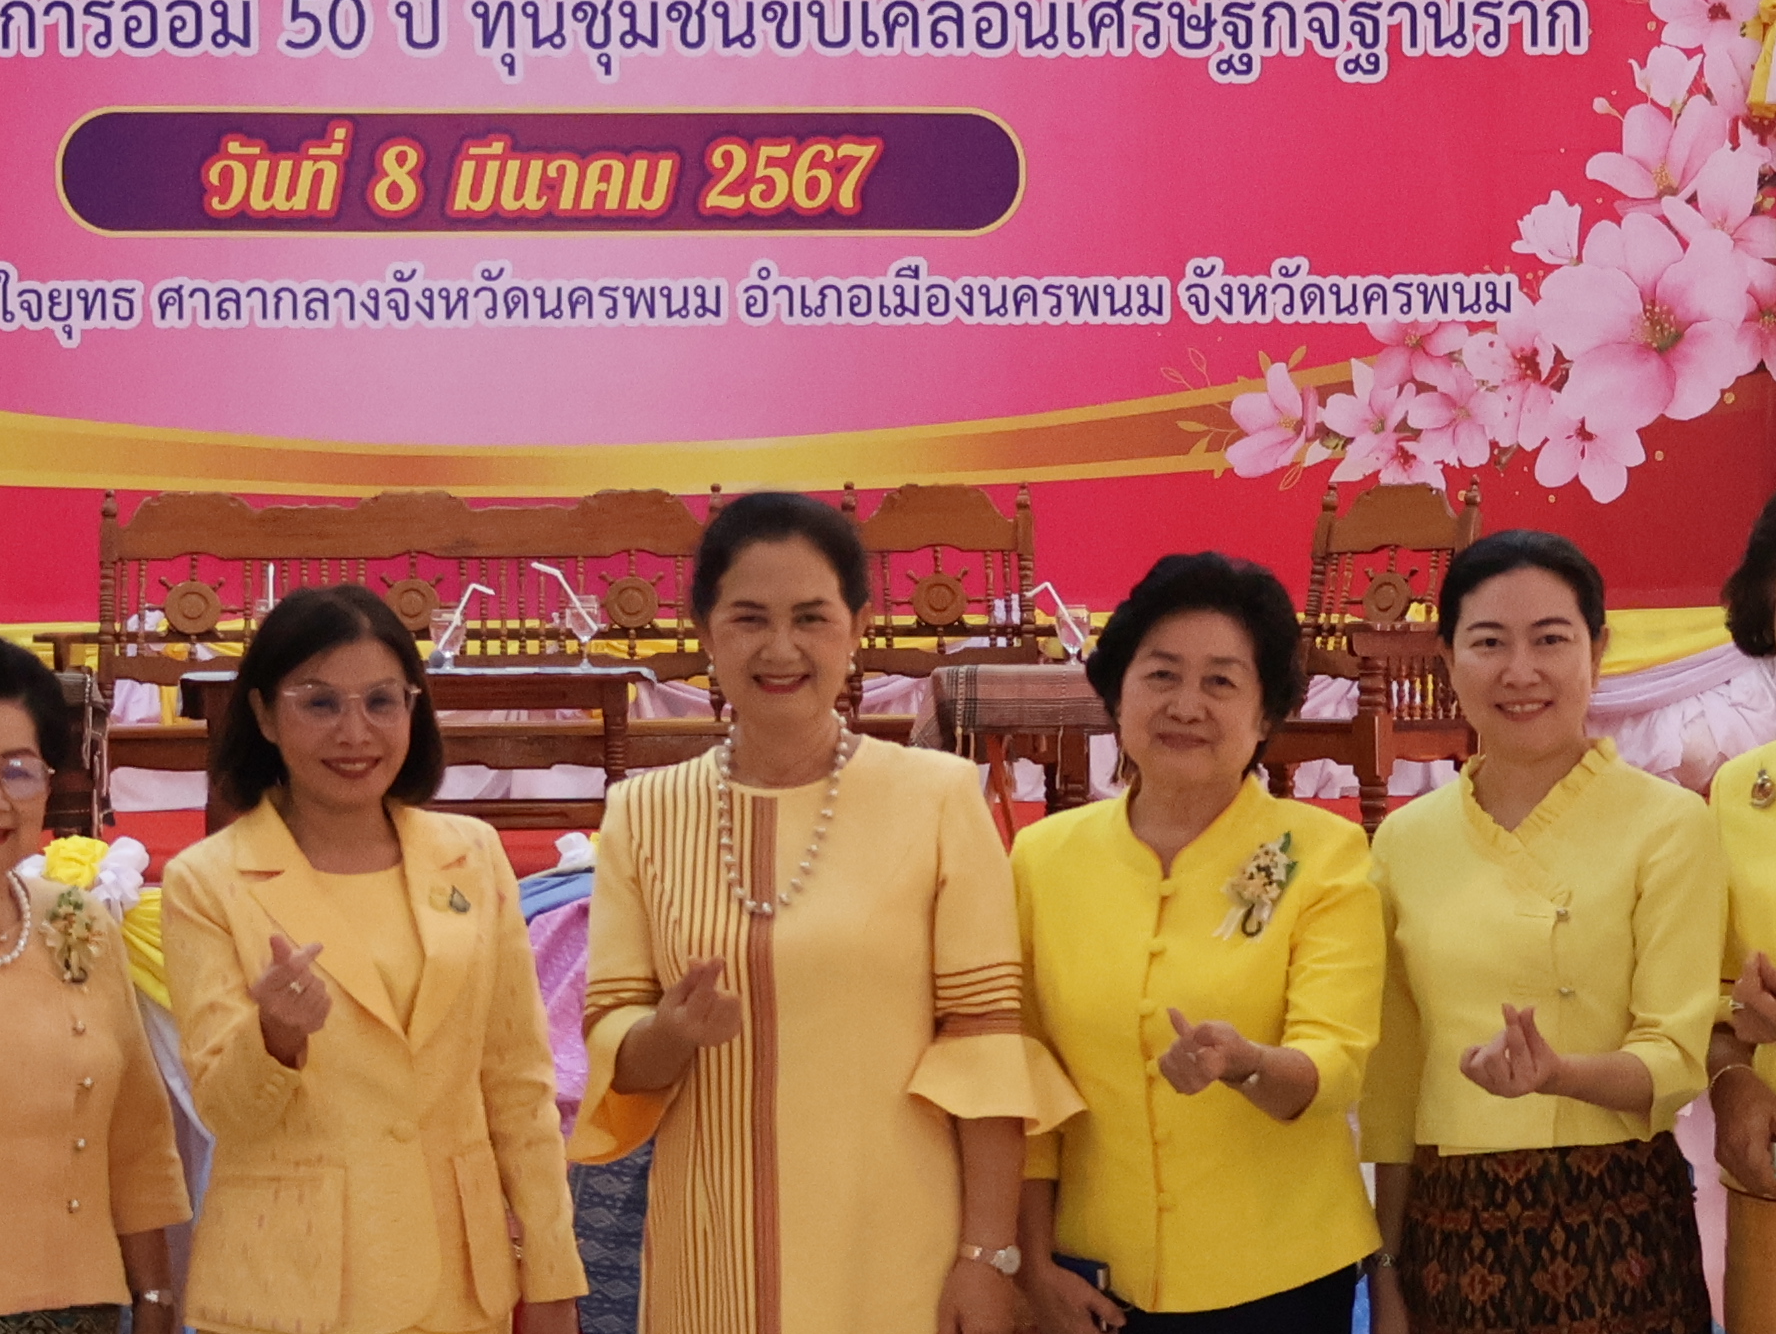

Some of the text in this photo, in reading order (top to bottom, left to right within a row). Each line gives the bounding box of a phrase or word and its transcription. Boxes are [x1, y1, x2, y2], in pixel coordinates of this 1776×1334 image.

[208, 127, 878, 213] วันที่ 8 มีนาคม 2567
[158, 268, 722, 322] ศาลากลางจังหวัดนครพนม
[744, 264, 1164, 319] อำเภอเมืองนครพนม
[1185, 264, 1512, 317] จังหวัดนครพนม
